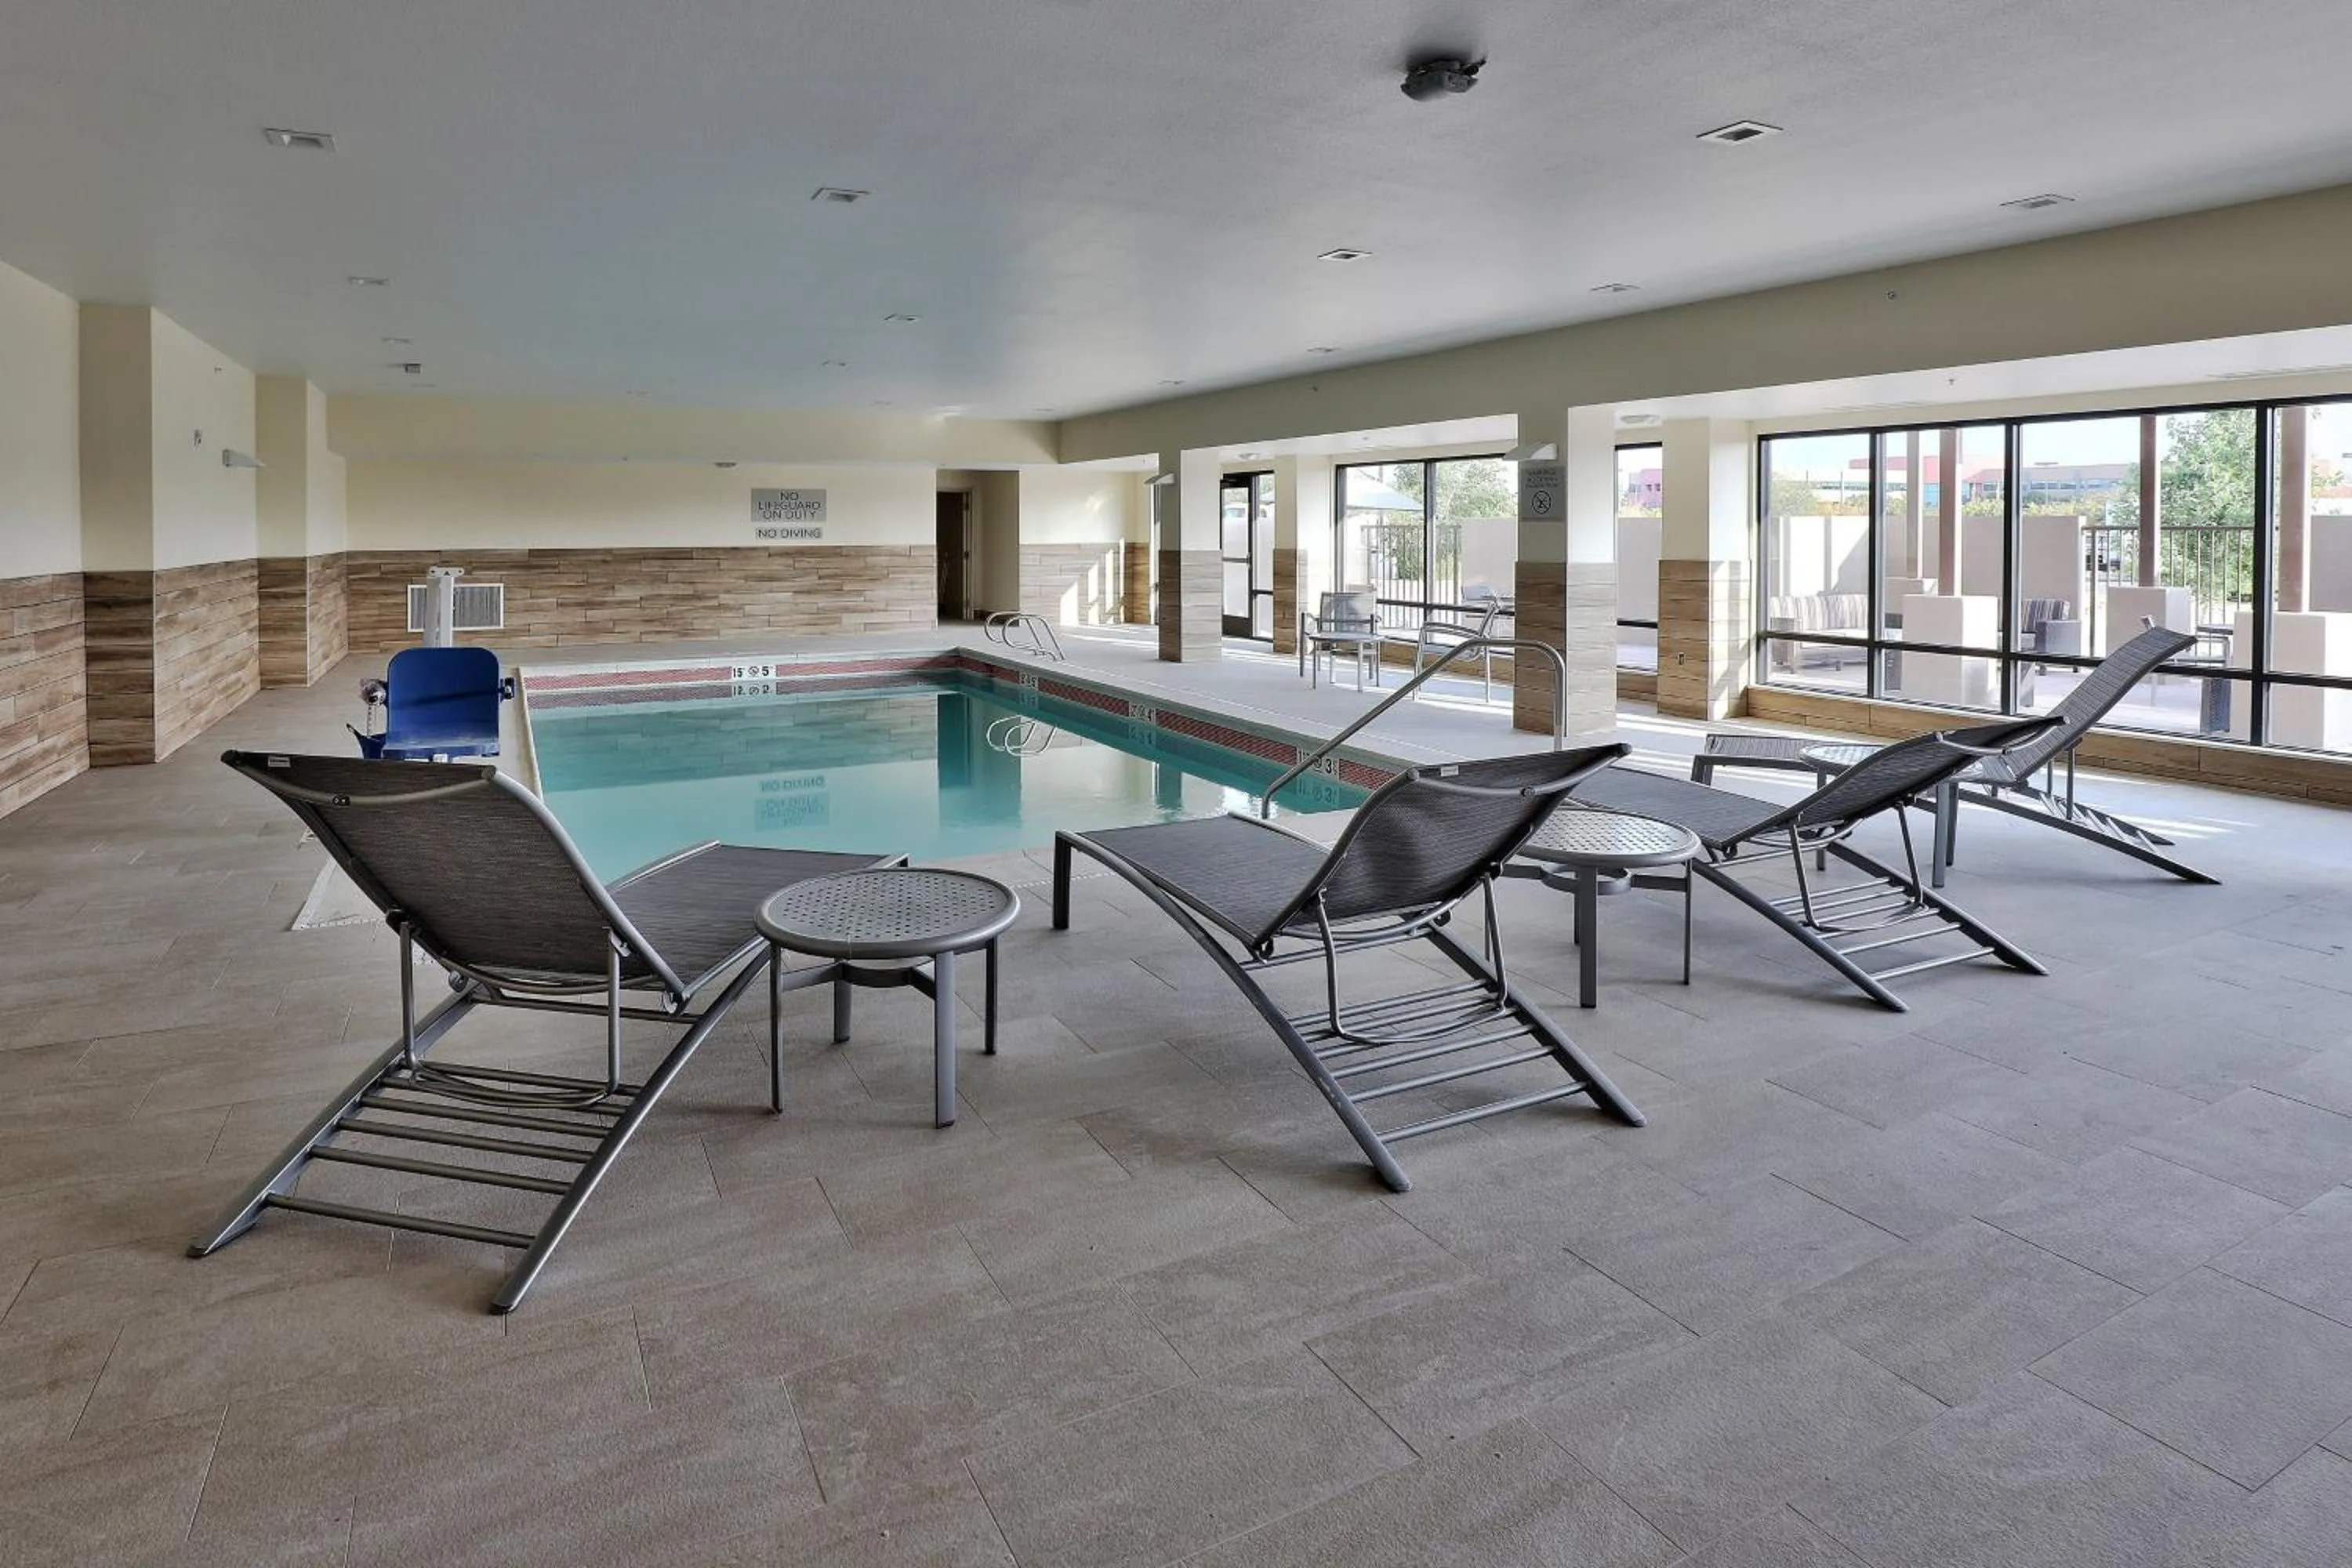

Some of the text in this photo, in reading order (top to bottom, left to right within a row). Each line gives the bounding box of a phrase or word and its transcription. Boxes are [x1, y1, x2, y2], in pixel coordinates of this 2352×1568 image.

[780, 492, 799, 501] NO
[758, 501, 821, 510] LIFEGUARD
[763, 510, 816, 520] ON DUTY
[758, 528, 821, 539] NO DIVING
[761, 666, 769, 677] 5
[1326, 758, 1332, 774] 3
